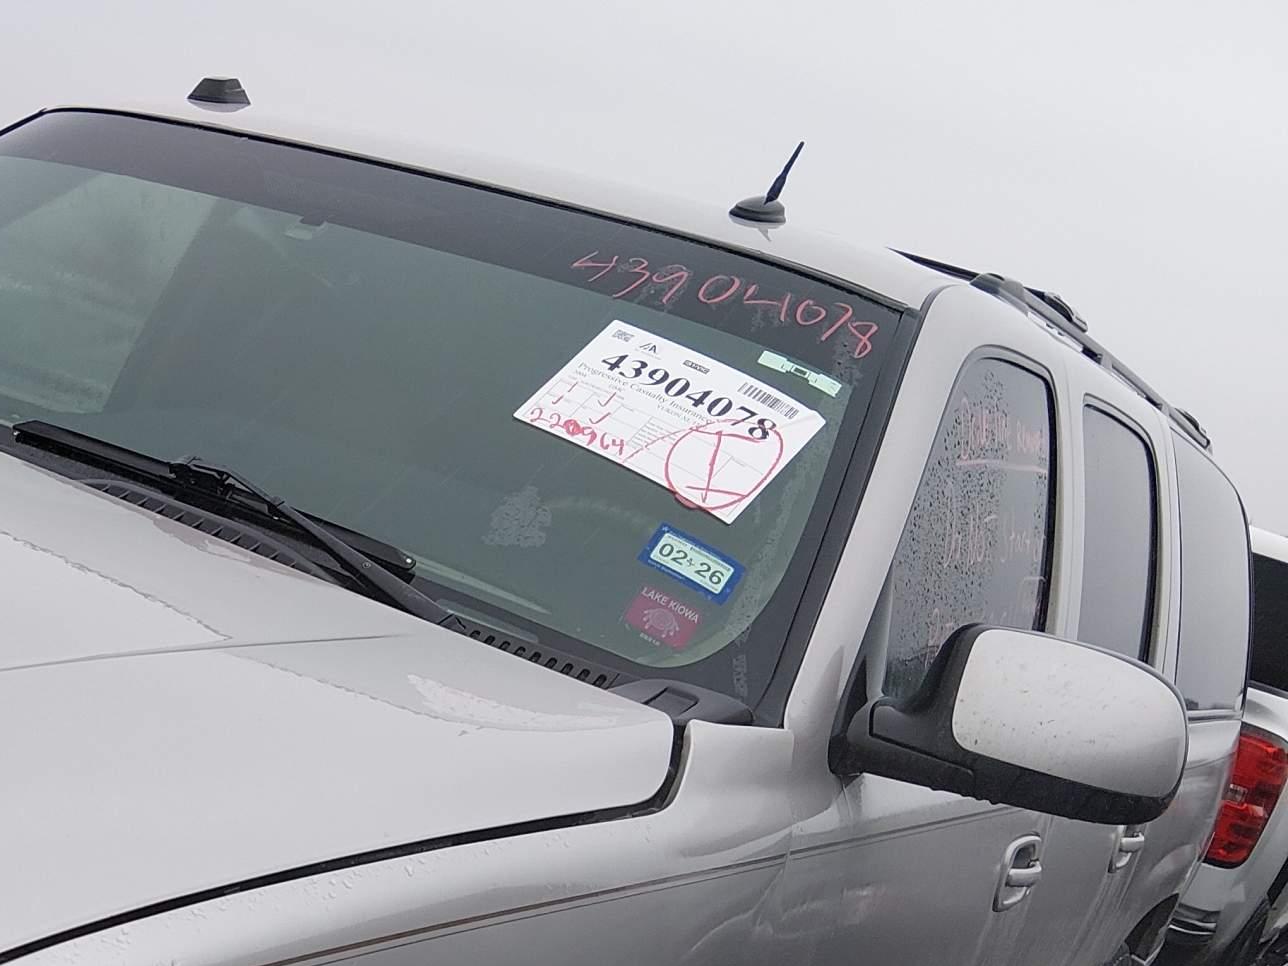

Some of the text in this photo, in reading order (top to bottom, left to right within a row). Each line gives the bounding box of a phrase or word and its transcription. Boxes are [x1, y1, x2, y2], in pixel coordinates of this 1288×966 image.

[571, 249, 880, 360] 43904078
[577, 361, 628, 386] Progressive
[629, 383, 666, 403] Casualty
[601, 352, 777, 440] 43904078
[658, 541, 688, 566] 02
[696, 562, 724, 585] 26
[641, 586, 699, 625] LAKE KIOWA
